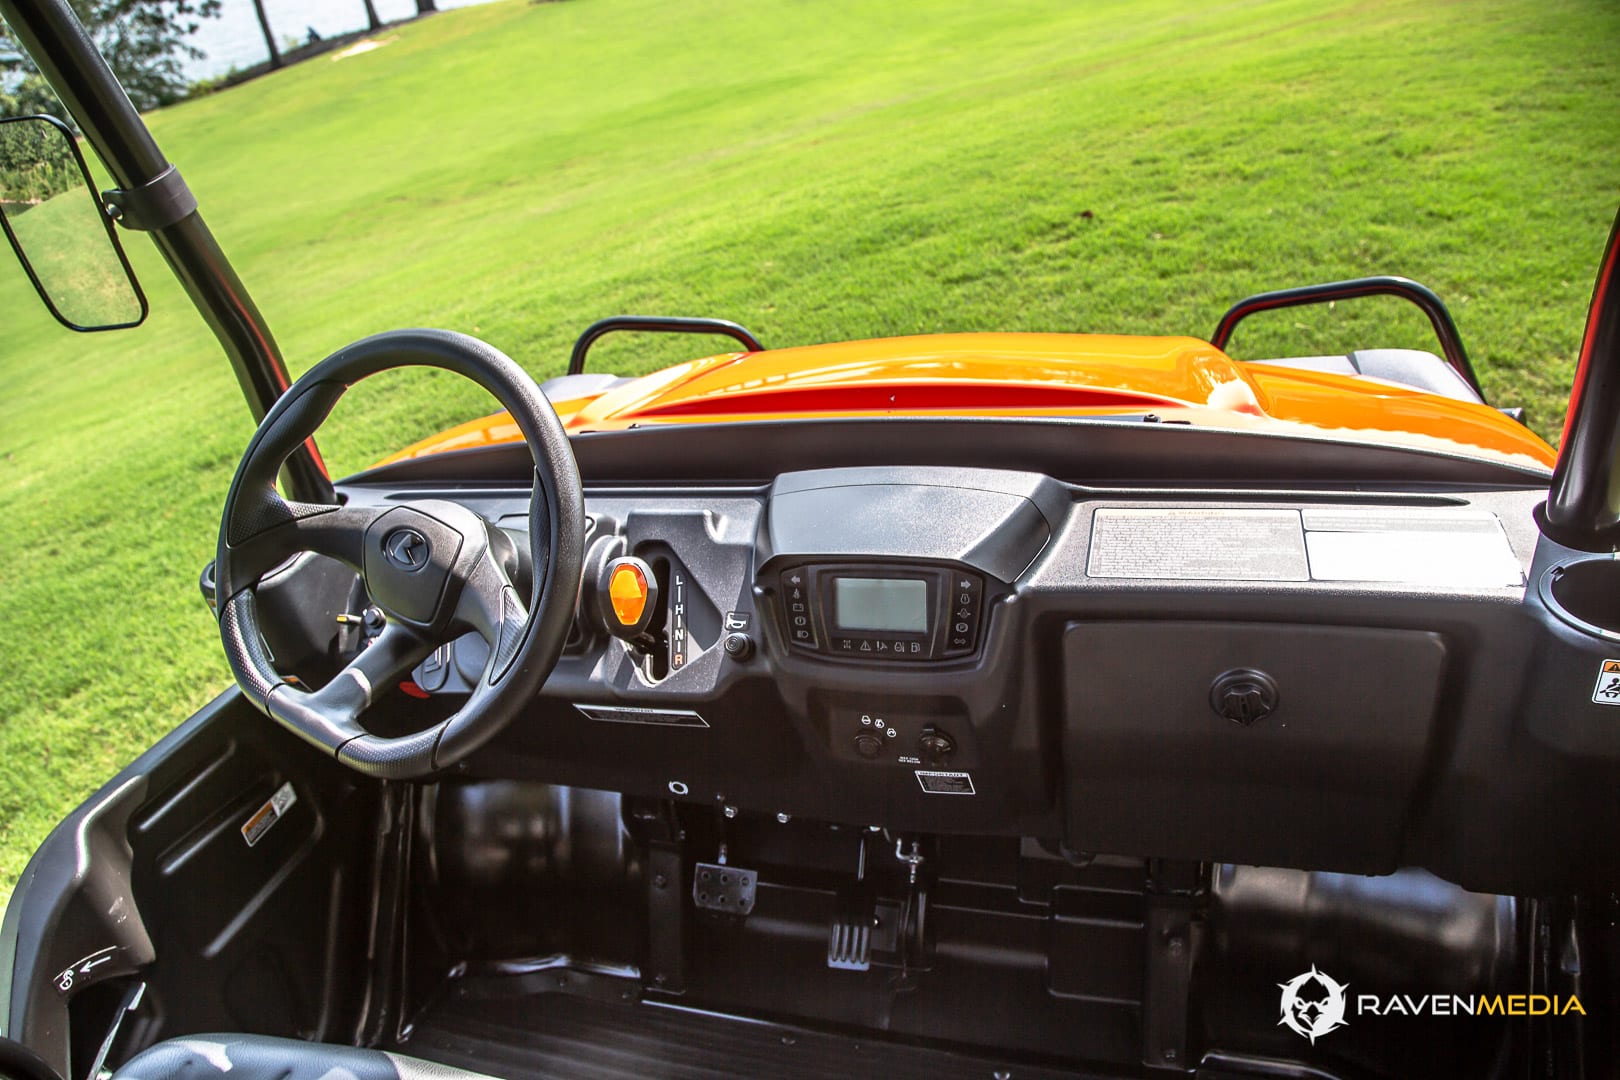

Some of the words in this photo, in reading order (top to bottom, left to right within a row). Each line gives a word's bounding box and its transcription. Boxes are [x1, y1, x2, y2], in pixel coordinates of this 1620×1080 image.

[676, 575, 683, 585] L
[675, 604, 683, 615] H
[675, 629, 684, 641] N
